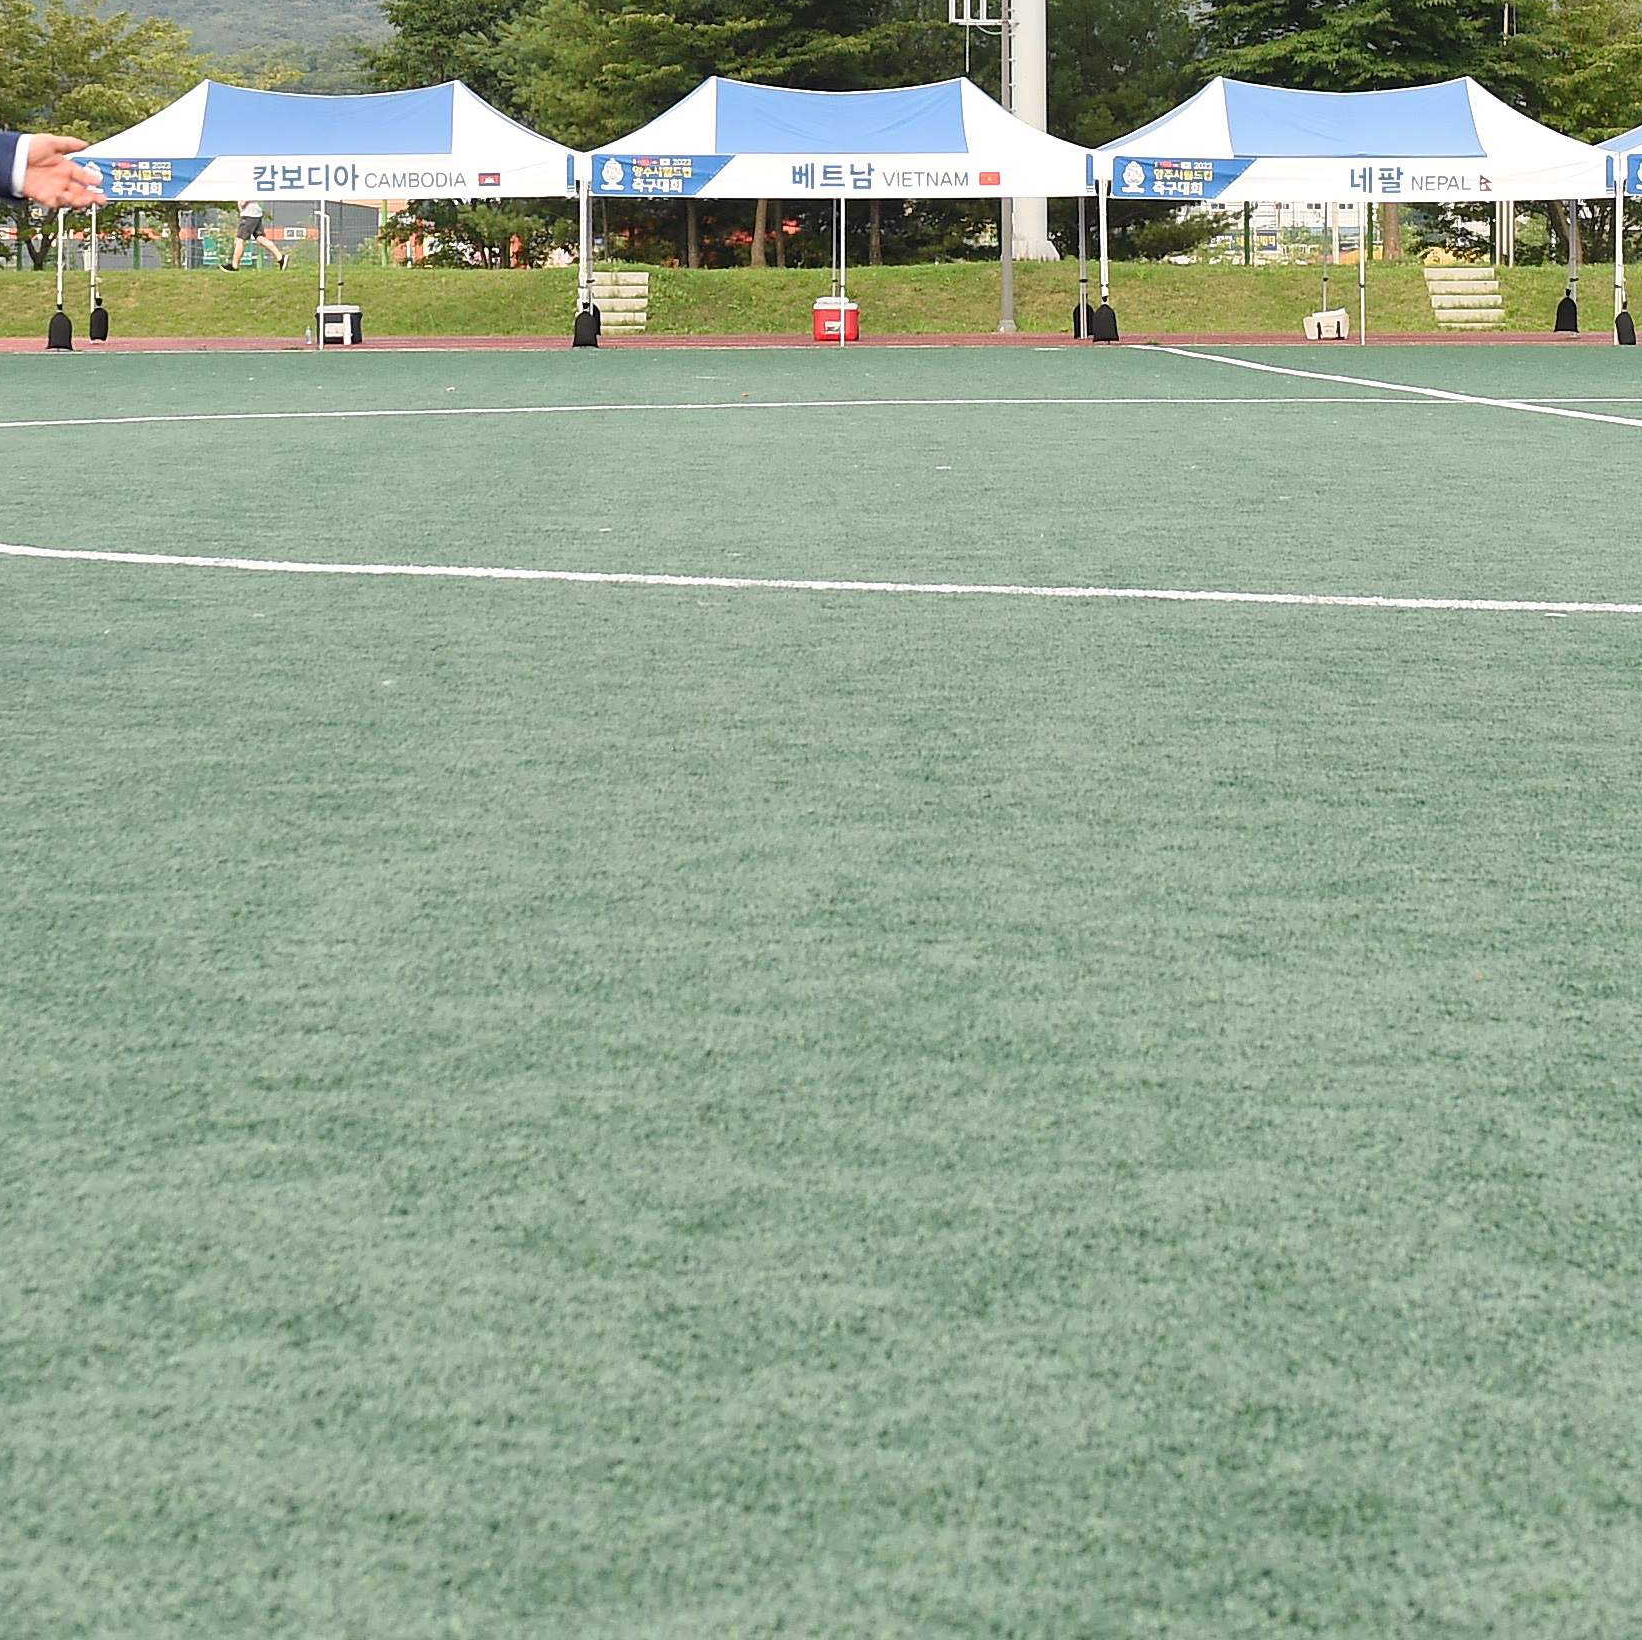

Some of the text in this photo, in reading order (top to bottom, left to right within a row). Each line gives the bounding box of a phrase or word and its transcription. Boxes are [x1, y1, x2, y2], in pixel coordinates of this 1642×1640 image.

[253, 164, 467, 192] 캄보디아 CAMBODIA
[632, 178, 683, 192] 축구대회
[791, 163, 969, 190] 베트남 VIETNAM
[1350, 166, 1472, 193] 네팔 NEPAL
[111, 182, 163, 196] 축구대회
[1152, 181, 1203, 196] 축구대회
